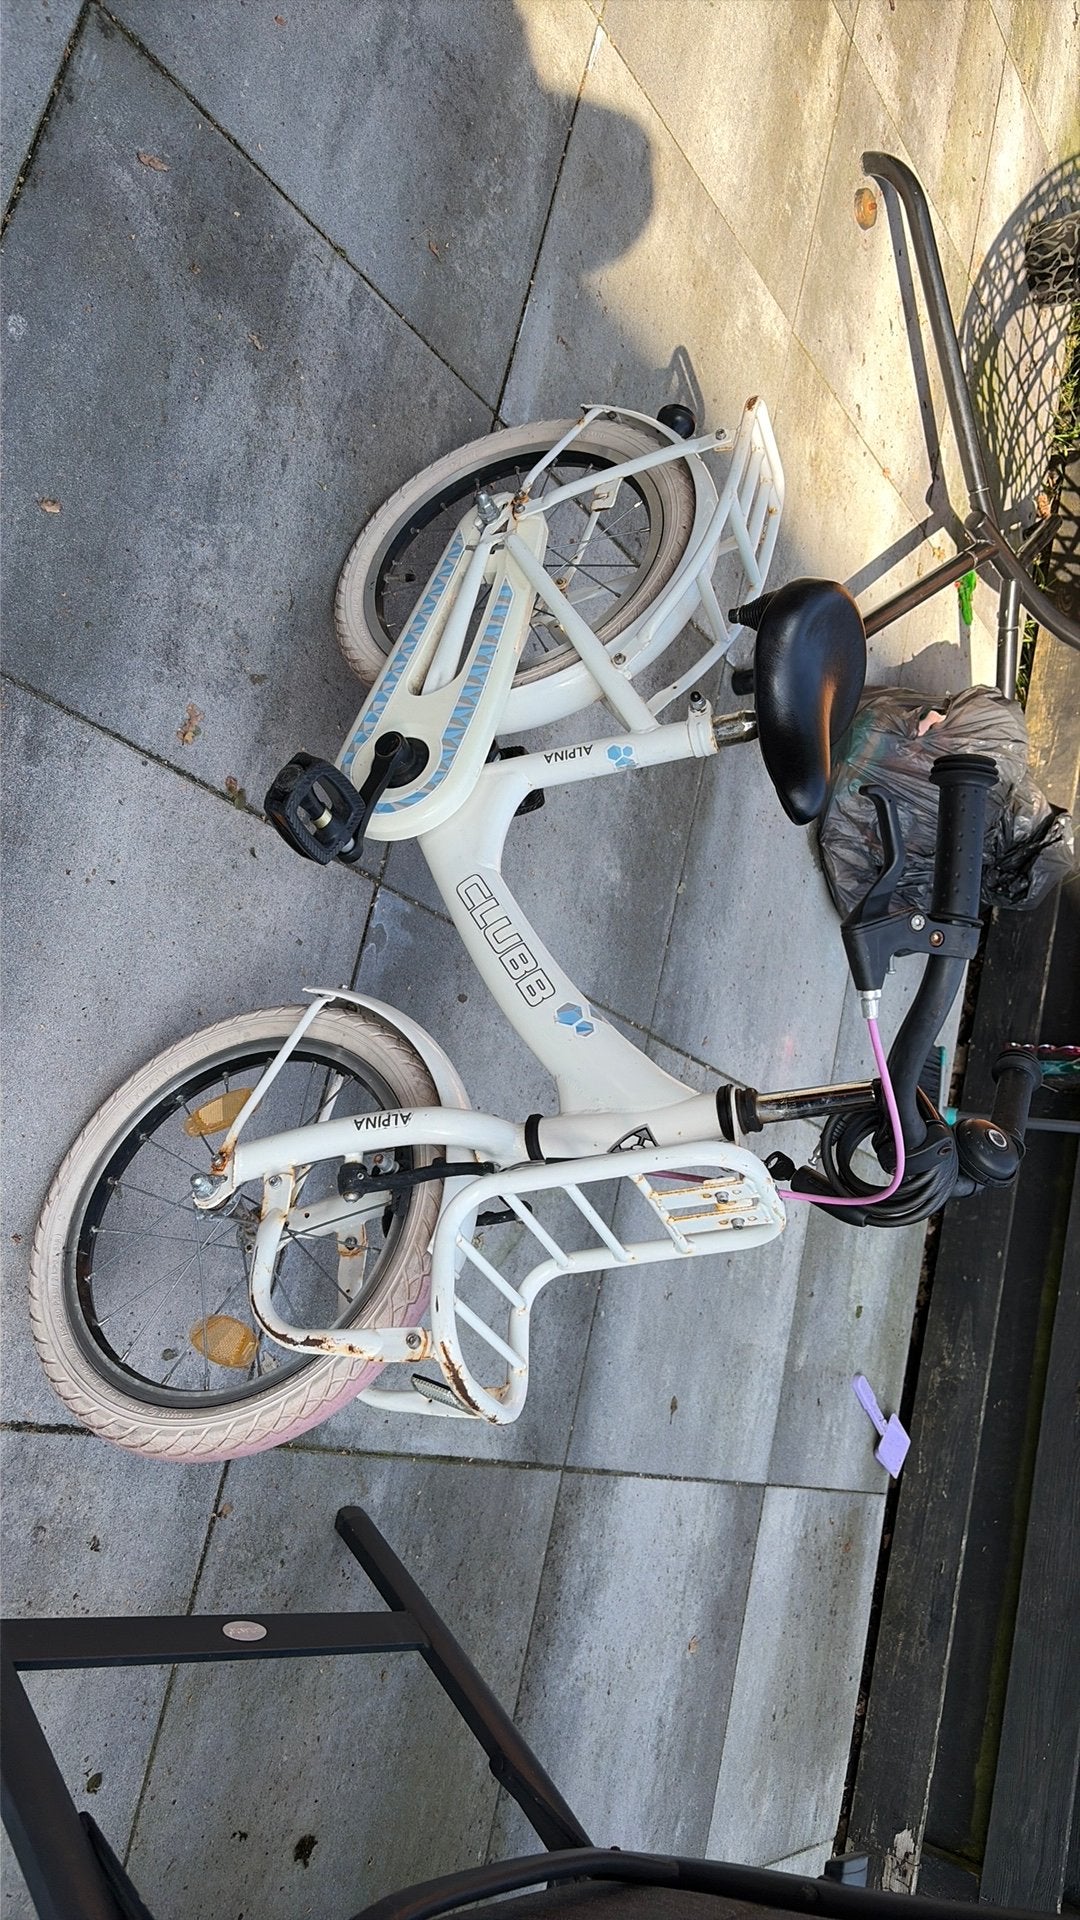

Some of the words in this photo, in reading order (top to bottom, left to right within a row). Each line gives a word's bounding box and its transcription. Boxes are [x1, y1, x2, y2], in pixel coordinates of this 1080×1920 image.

[543, 744, 593, 764] ALPINA
[456, 873, 556, 1007] CLUBB
[353, 1111, 412, 1131] ALPINA
